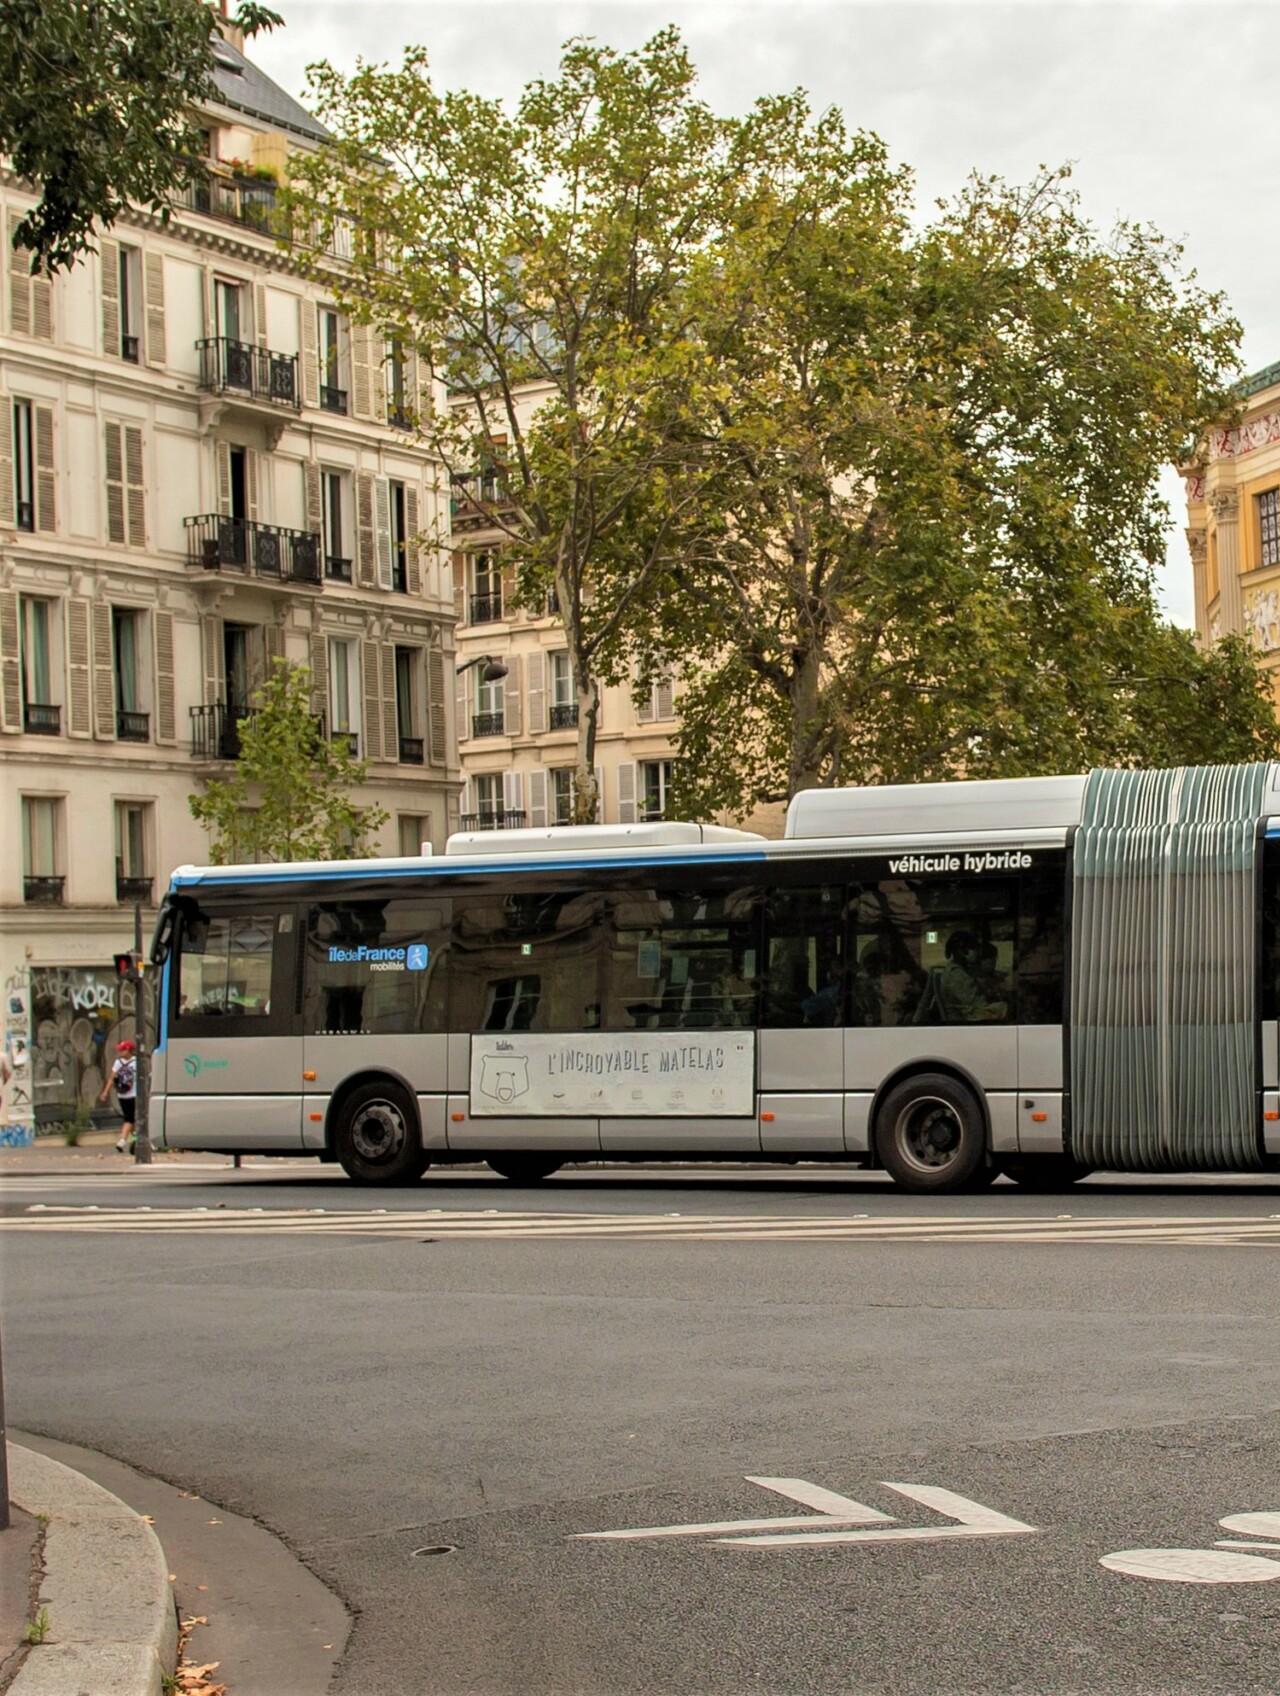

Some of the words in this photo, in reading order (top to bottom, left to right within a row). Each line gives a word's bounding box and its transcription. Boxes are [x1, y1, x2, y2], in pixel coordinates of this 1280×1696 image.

[888, 855, 961, 874] véhicule
[963, 851, 1032, 873] hybride
[369, 960, 406, 972] mobilités
[548, 1048, 650, 1075] L'INCROYABLE
[659, 1046, 725, 1073] MATELAS
